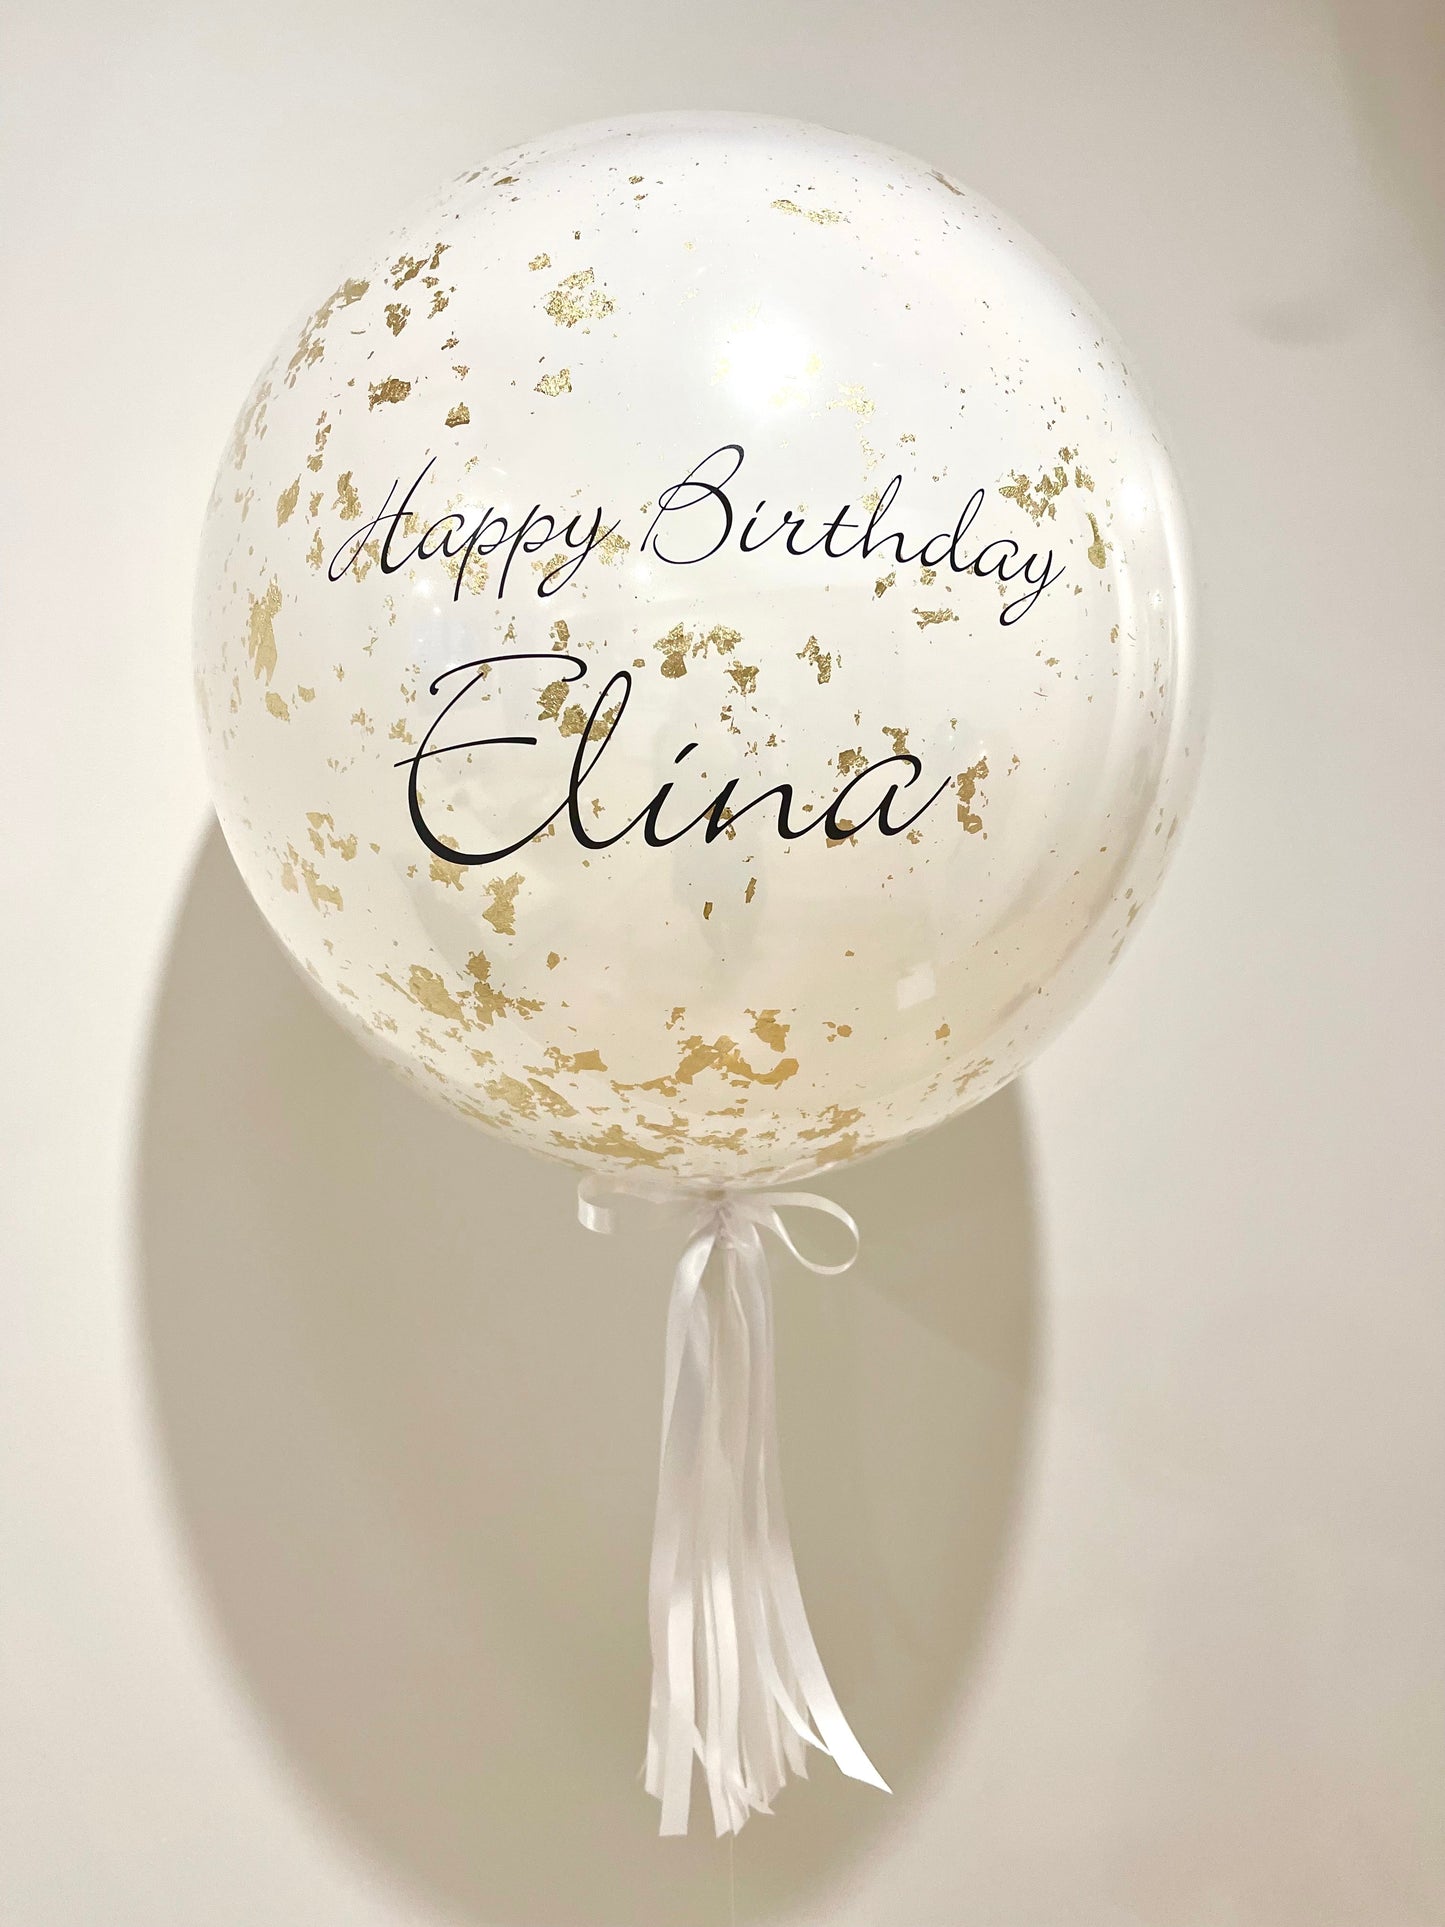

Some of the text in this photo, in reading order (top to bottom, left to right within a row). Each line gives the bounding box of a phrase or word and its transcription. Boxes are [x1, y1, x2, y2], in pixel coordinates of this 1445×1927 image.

[329, 445, 1066, 627] Happy Birthday
[394, 654, 952, 866] Elina
